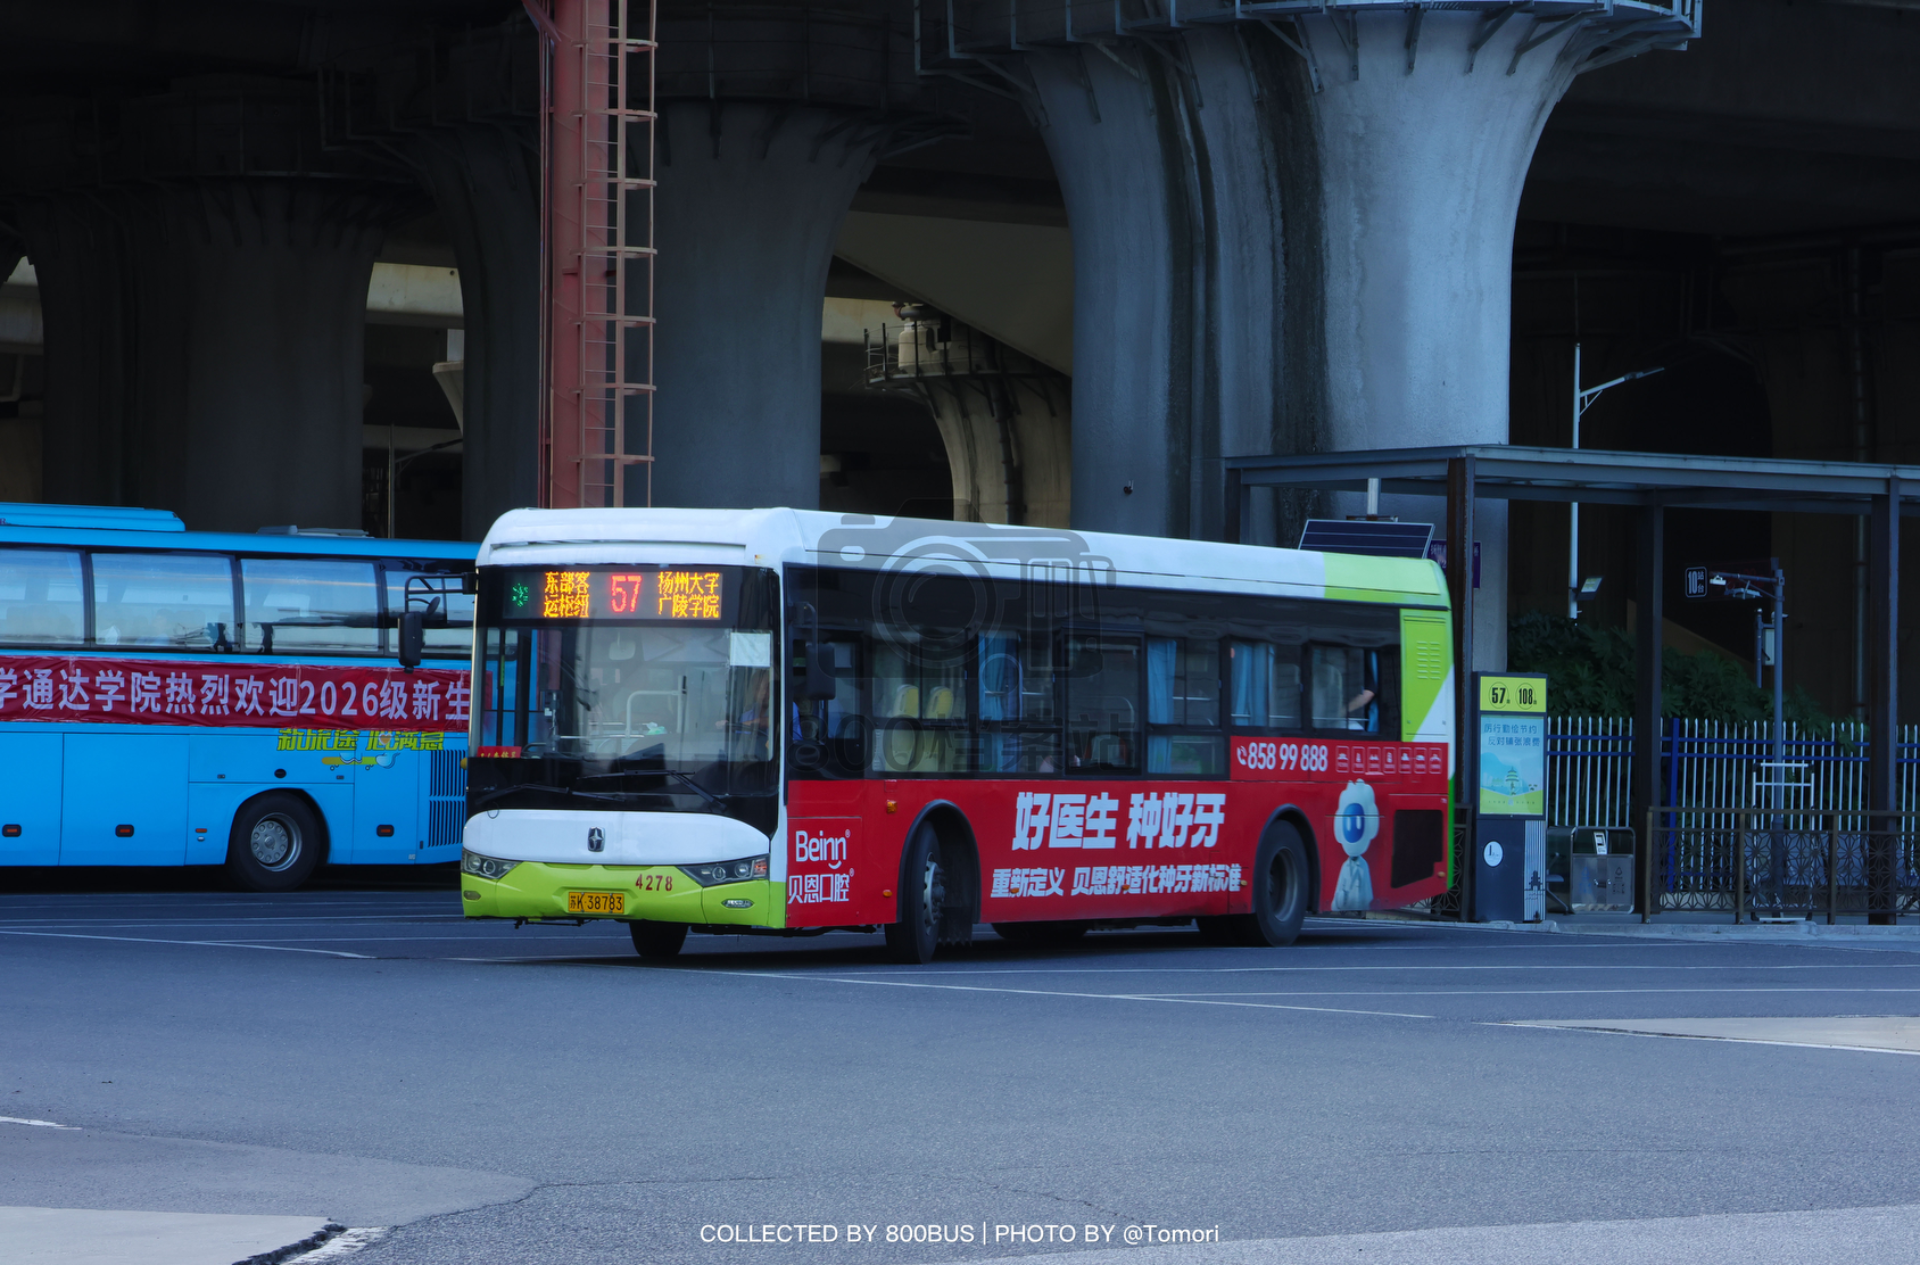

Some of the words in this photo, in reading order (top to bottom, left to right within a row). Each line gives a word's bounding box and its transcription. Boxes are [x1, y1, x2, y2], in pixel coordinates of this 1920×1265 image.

[544, 571, 590, 594] 东部客
[611, 575, 642, 613] 57
[658, 571, 720, 595] 扬州大学
[543, 594, 590, 618] 运枢纽
[658, 594, 720, 618] 广陵学院
[0, 667, 470, 721] 学通达学院热烈欢迎2026级新生
[1248, 742, 1276, 770] 858
[1279, 743, 1298, 771] 99
[1300, 744, 1328, 772] 888
[1012, 792, 1118, 851] 好医生
[1126, 792, 1226, 849] 种好牙
[635, 874, 673, 891] 4278
[787, 873, 850, 904] 贝恩口腔
[990, 867, 1065, 898] 重新定义
[1071, 863, 1242, 896] 贝恩舒适化种牙新标准
